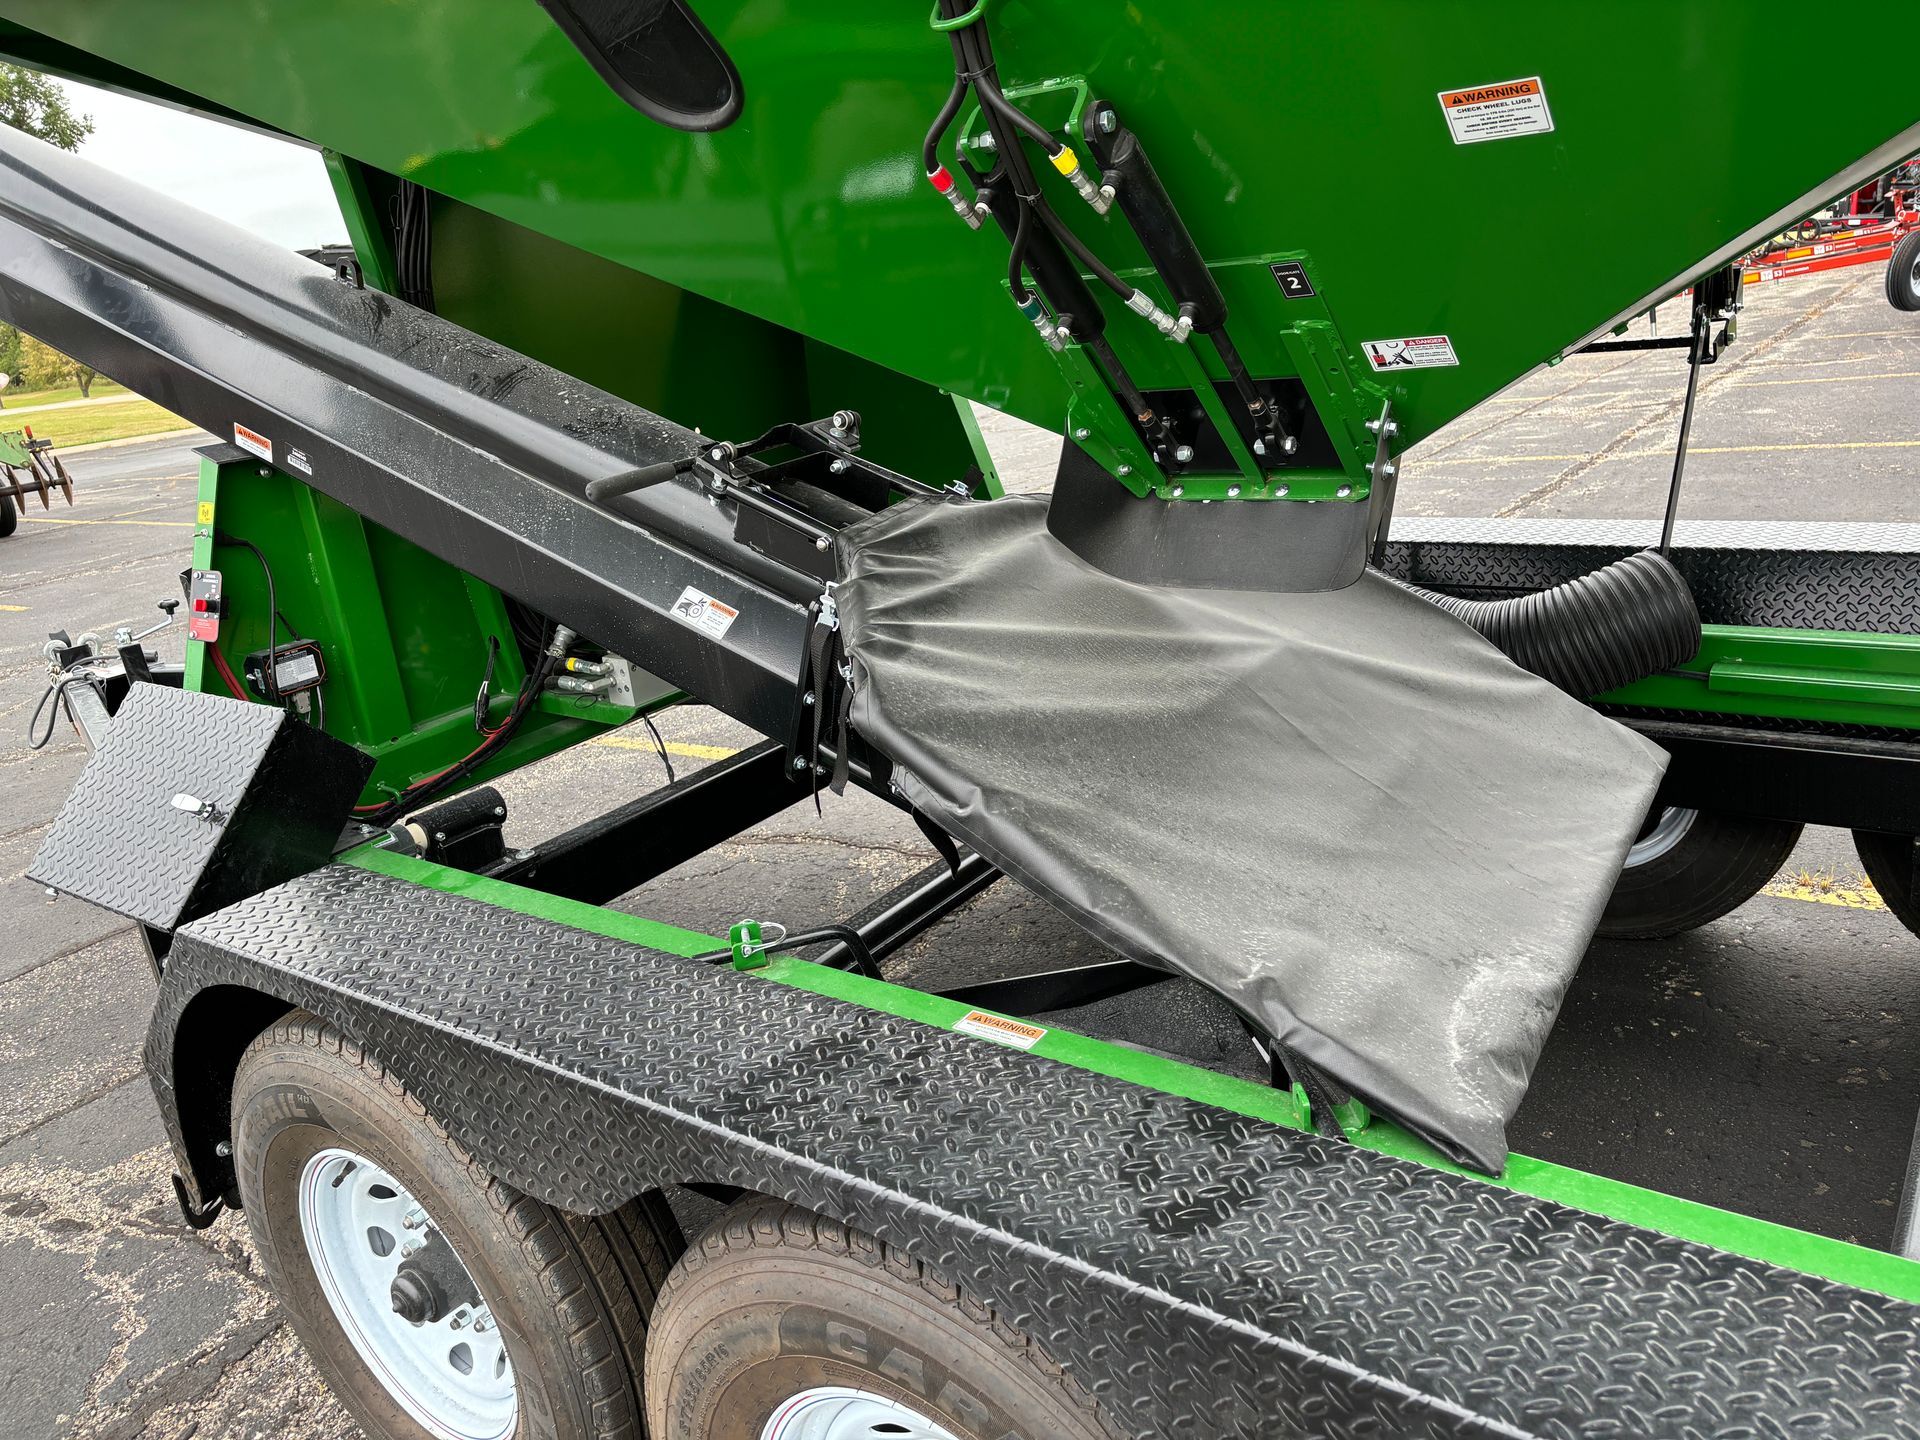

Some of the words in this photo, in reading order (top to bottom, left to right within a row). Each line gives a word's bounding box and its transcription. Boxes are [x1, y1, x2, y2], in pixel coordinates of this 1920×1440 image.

[1462, 84, 1531, 102] WARNING
[1456, 106, 1482, 114] CHECK
[1484, 101, 1510, 110] WHEEL
[1511, 98, 1532, 106] LUGS
[1287, 277, 1302, 289] 2
[242, 429, 268, 448] WARNING
[983, 1016, 1036, 1037] WARNING
